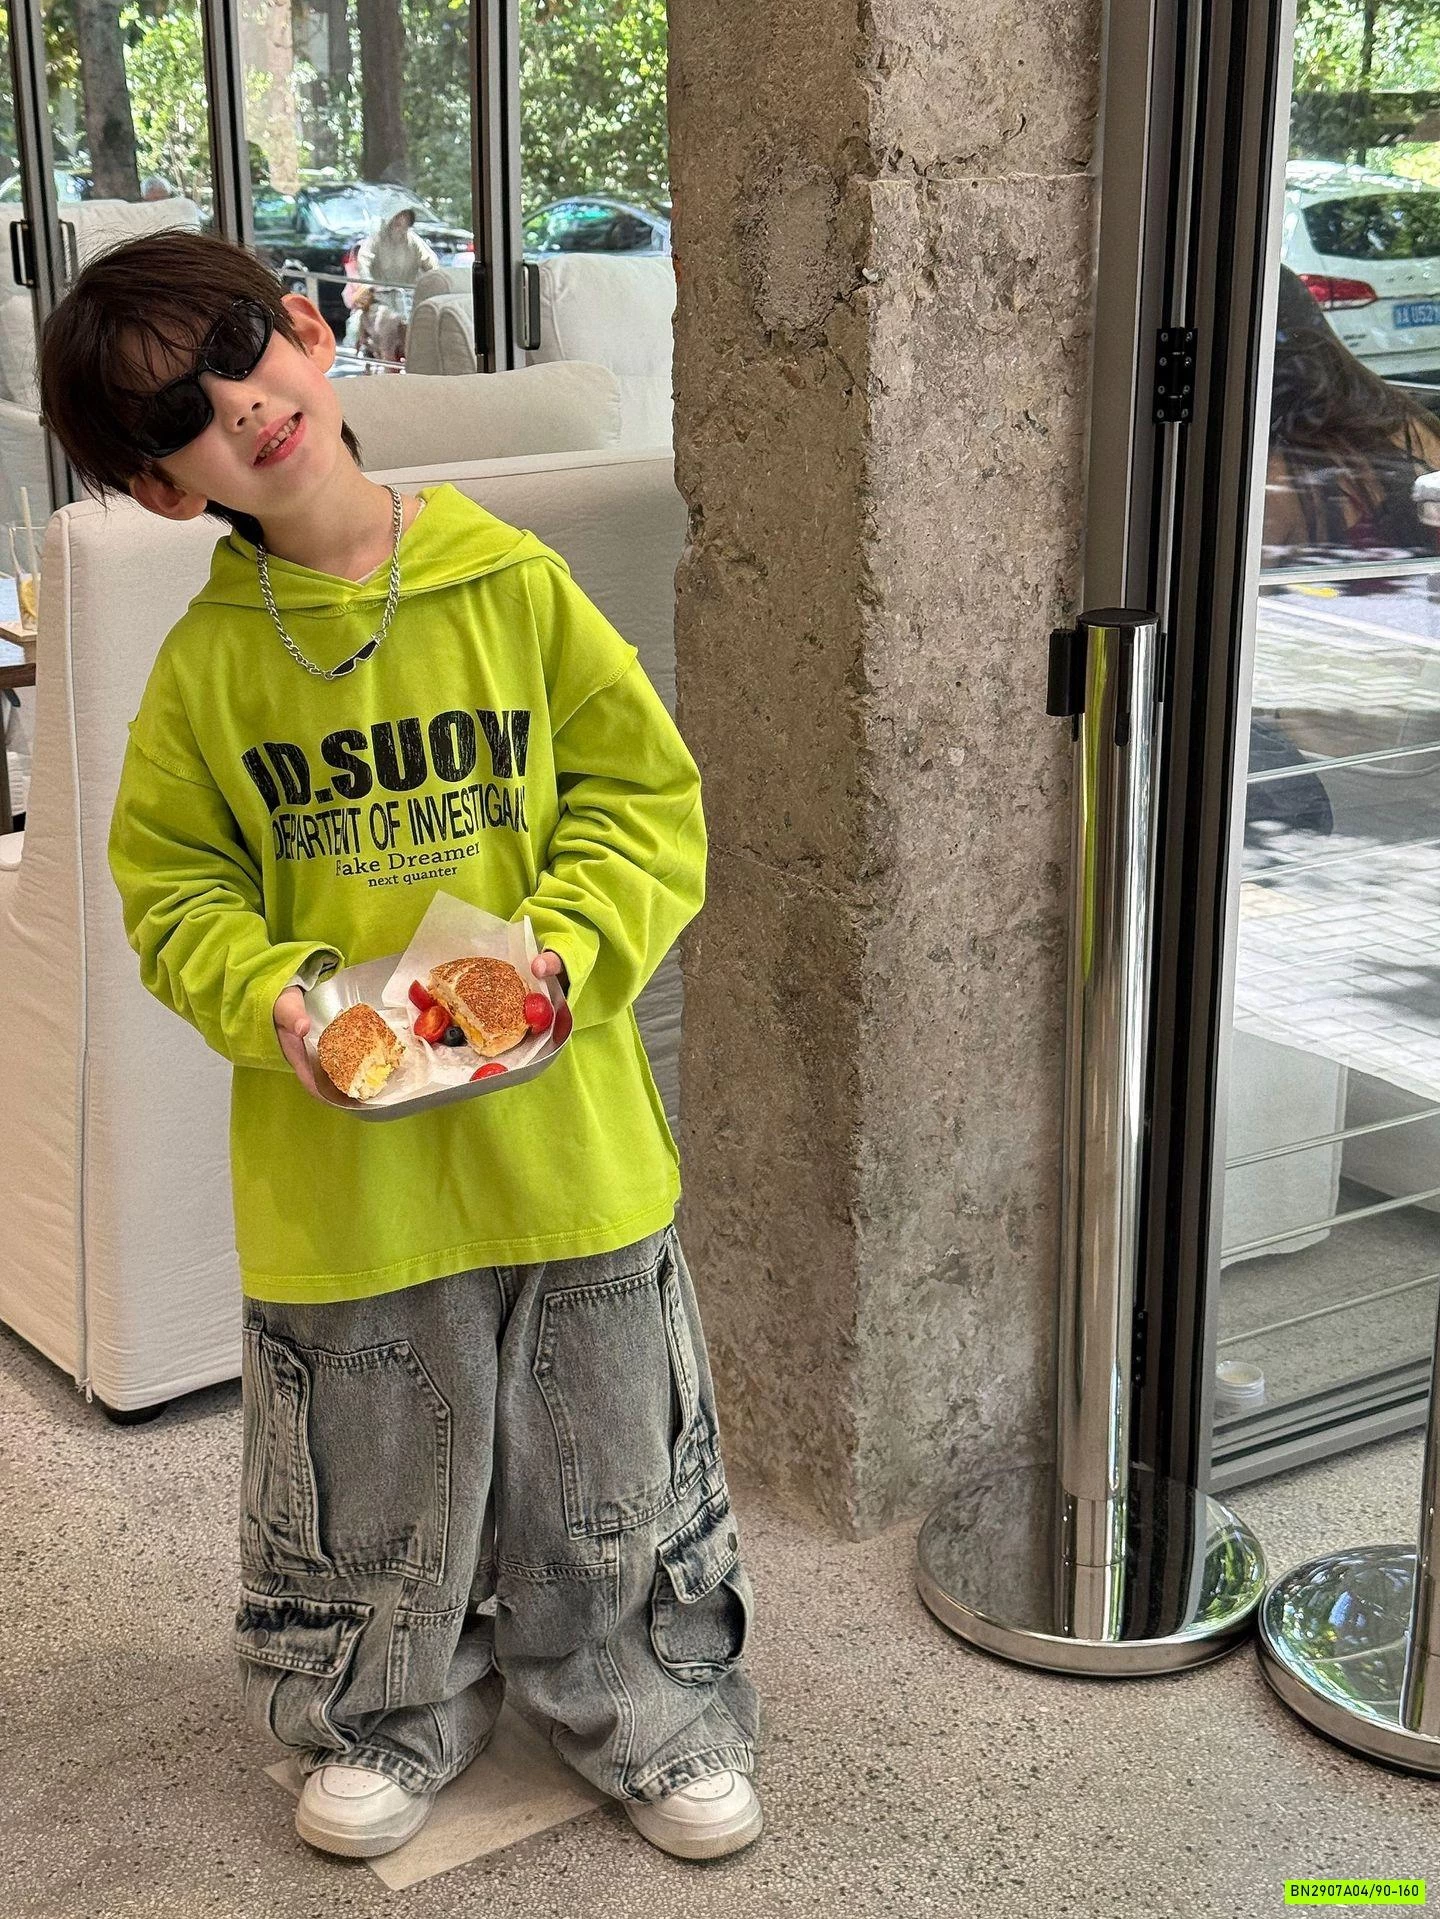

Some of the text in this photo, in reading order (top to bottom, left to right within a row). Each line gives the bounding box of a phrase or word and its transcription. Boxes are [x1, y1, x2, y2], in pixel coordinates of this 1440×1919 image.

[369, 801, 400, 850] OF
[388, 841, 480, 870] Dreamer
[368, 866, 457, 887] next quanter
